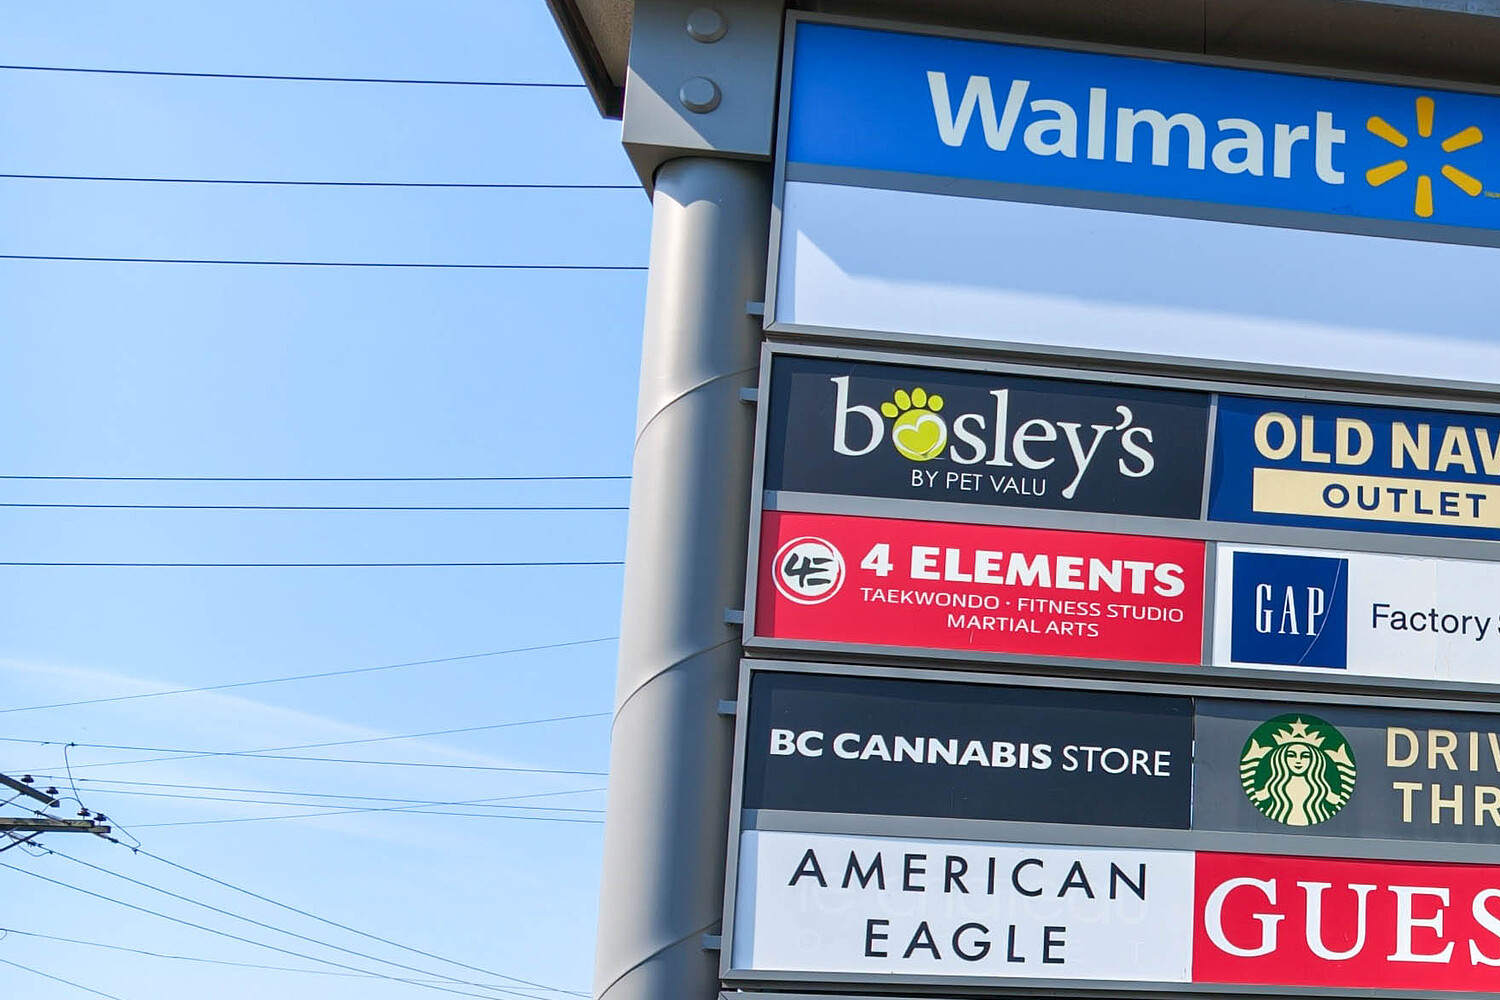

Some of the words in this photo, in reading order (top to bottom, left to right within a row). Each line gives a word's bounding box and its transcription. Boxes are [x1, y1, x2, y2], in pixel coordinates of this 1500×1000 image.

[926, 71, 1346, 185] Walmart
[831, 376, 1155, 499] bosley's
[1254, 412, 1373, 466] OLD
[912, 470, 941, 488] BY
[947, 471, 982, 491] PET
[990, 474, 1046, 497] VALU
[1322, 483, 1487, 519] OUTLET
[861, 544, 893, 576] 4
[911, 546, 1184, 598] ELEMENTS
[860, 587, 999, 610] TAEKWONDO
[1018, 597, 1100, 617] FITNESS
[1107, 604, 1184, 623] STUDIO
[948, 614, 1041, 634] MARTIAL
[1045, 621, 1099, 638] ARTS
[1256, 584, 1326, 636] GAP
[1373, 604, 1491, 641] Factory
[770, 729, 823, 757] BC
[834, 733, 1052, 770] CANNABIS
[1063, 745, 1171, 777] STORE
[789, 848, 1148, 901] AMERICAN
[865, 919, 1067, 964] EAGLE
